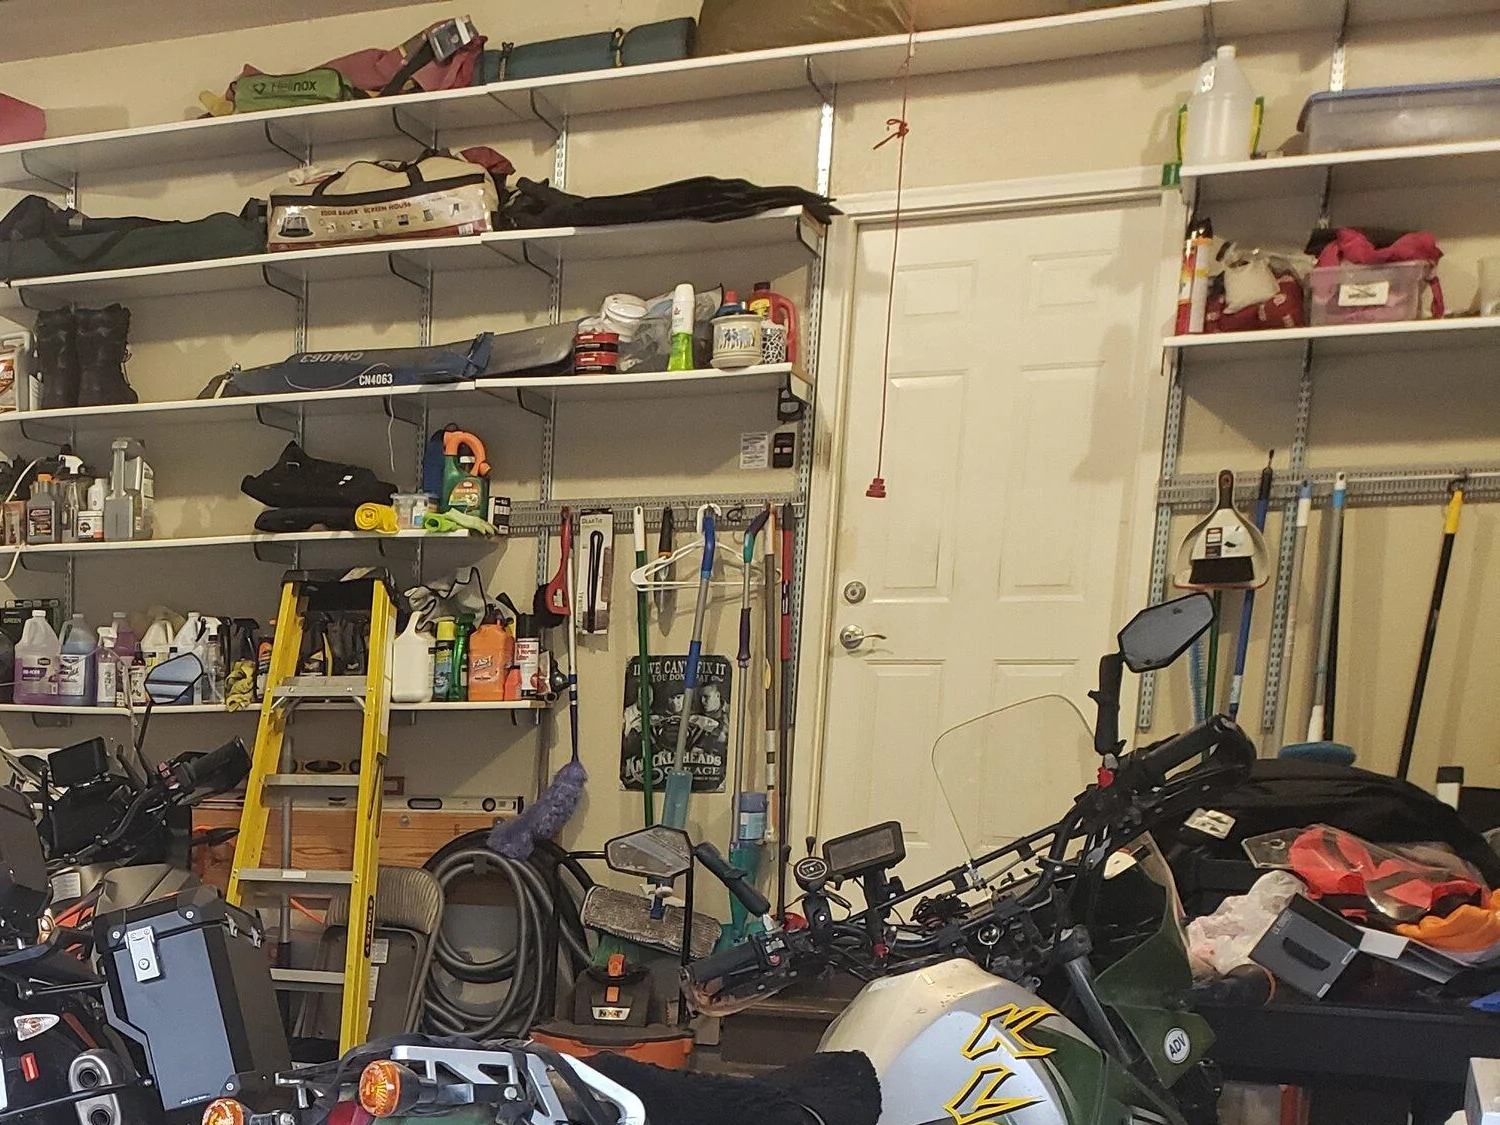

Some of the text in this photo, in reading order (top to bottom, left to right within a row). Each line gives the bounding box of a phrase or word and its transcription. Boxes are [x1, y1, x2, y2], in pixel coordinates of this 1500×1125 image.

[358, 373, 394, 386] CN4063
[715, 662, 727, 676] IT
[651, 674, 668, 683] YOU
[1169, 1033, 1186, 1058] ADV
